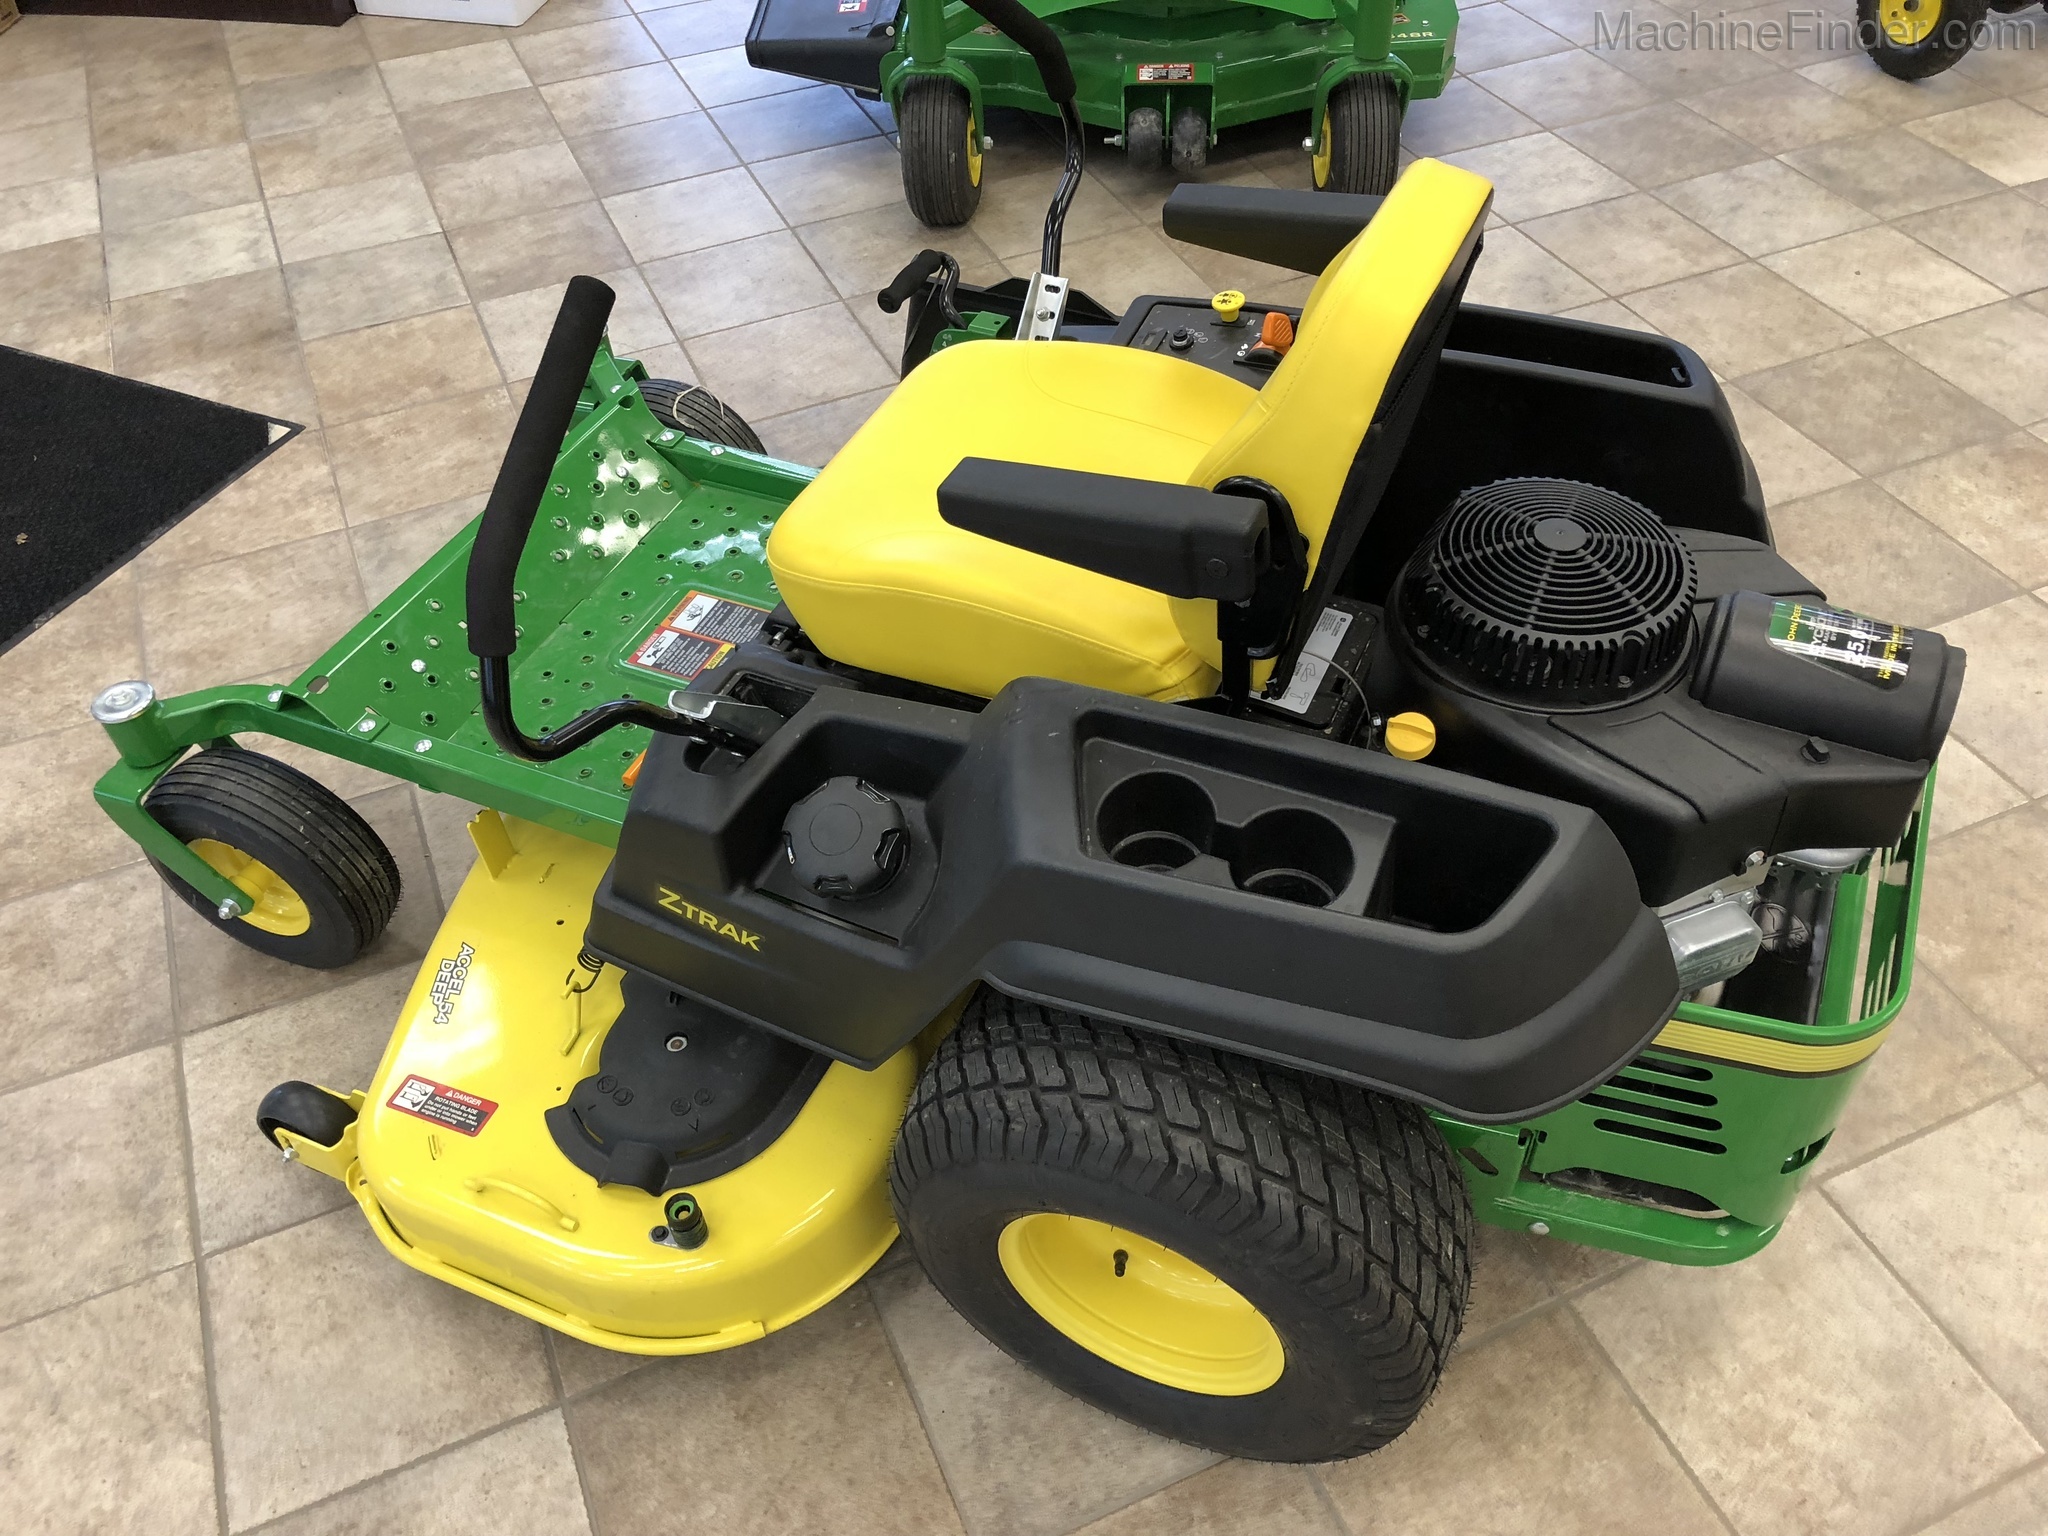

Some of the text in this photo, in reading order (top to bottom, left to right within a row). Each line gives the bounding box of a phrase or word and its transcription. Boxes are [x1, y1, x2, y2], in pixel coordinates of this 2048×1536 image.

[658, 886, 761, 952] ZTRAK
[429, 958, 456, 1006] DEEP
[433, 941, 475, 1024] ACCEL 54
[434, 1096, 479, 1115] ROTATING BLADE
[453, 1092, 482, 1106] DANGER
